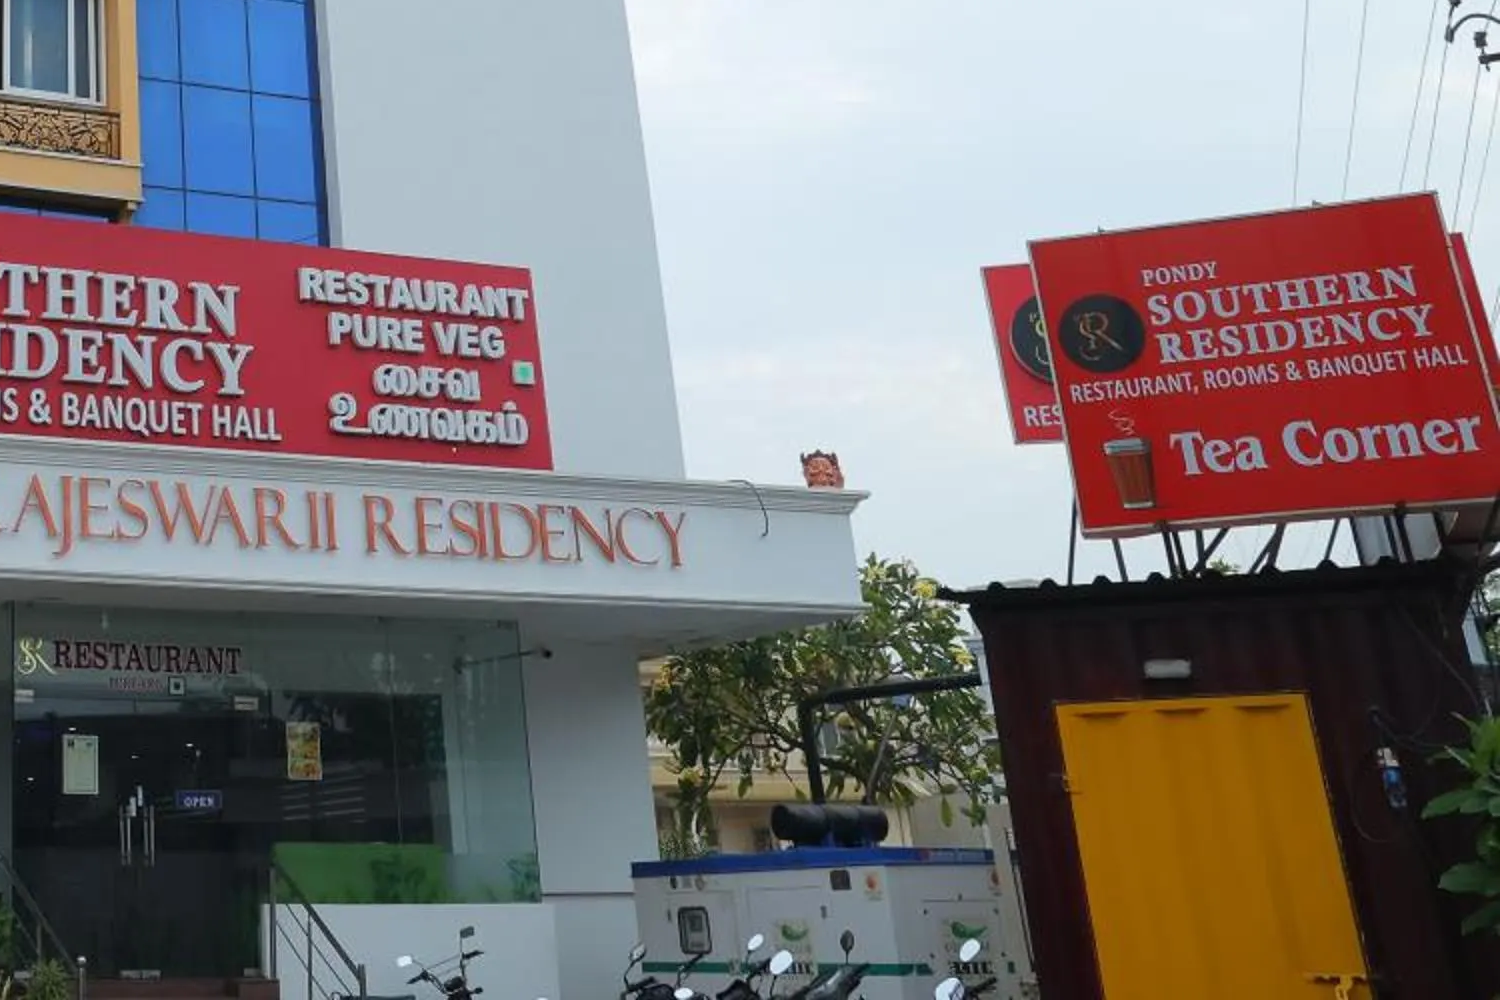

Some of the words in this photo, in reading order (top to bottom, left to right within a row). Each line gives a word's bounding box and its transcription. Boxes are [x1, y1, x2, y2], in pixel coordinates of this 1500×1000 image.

[299, 267, 529, 321] RESTAURANT
[1140, 261, 1218, 287] PONDY
[1146, 264, 1418, 326] SOUTHERN
[327, 311, 425, 353] PURE
[433, 321, 506, 359] VEG
[1156, 303, 1434, 364] RESIDENCY
[373, 363, 481, 401] சைவ
[1069, 370, 1199, 404] RESTAURANT,
[1203, 364, 1279, 390] ROOMS
[1285, 360, 1301, 381] &
[1307, 349, 1407, 380] BANQUET
[1414, 344, 1469, 369] HALL
[28, 390, 53, 427] &
[62, 395, 203, 438] BANQUET
[212, 404, 282, 442] HALL
[329, 393, 529, 446] உணவகம்
[1170, 431, 1268, 477] Tea
[1282, 414, 1483, 468] Corner
[363, 493, 687, 569] RESIDENCY
[54, 640, 242, 674] RESTAURANT
[183, 796, 214, 808] OPEN
